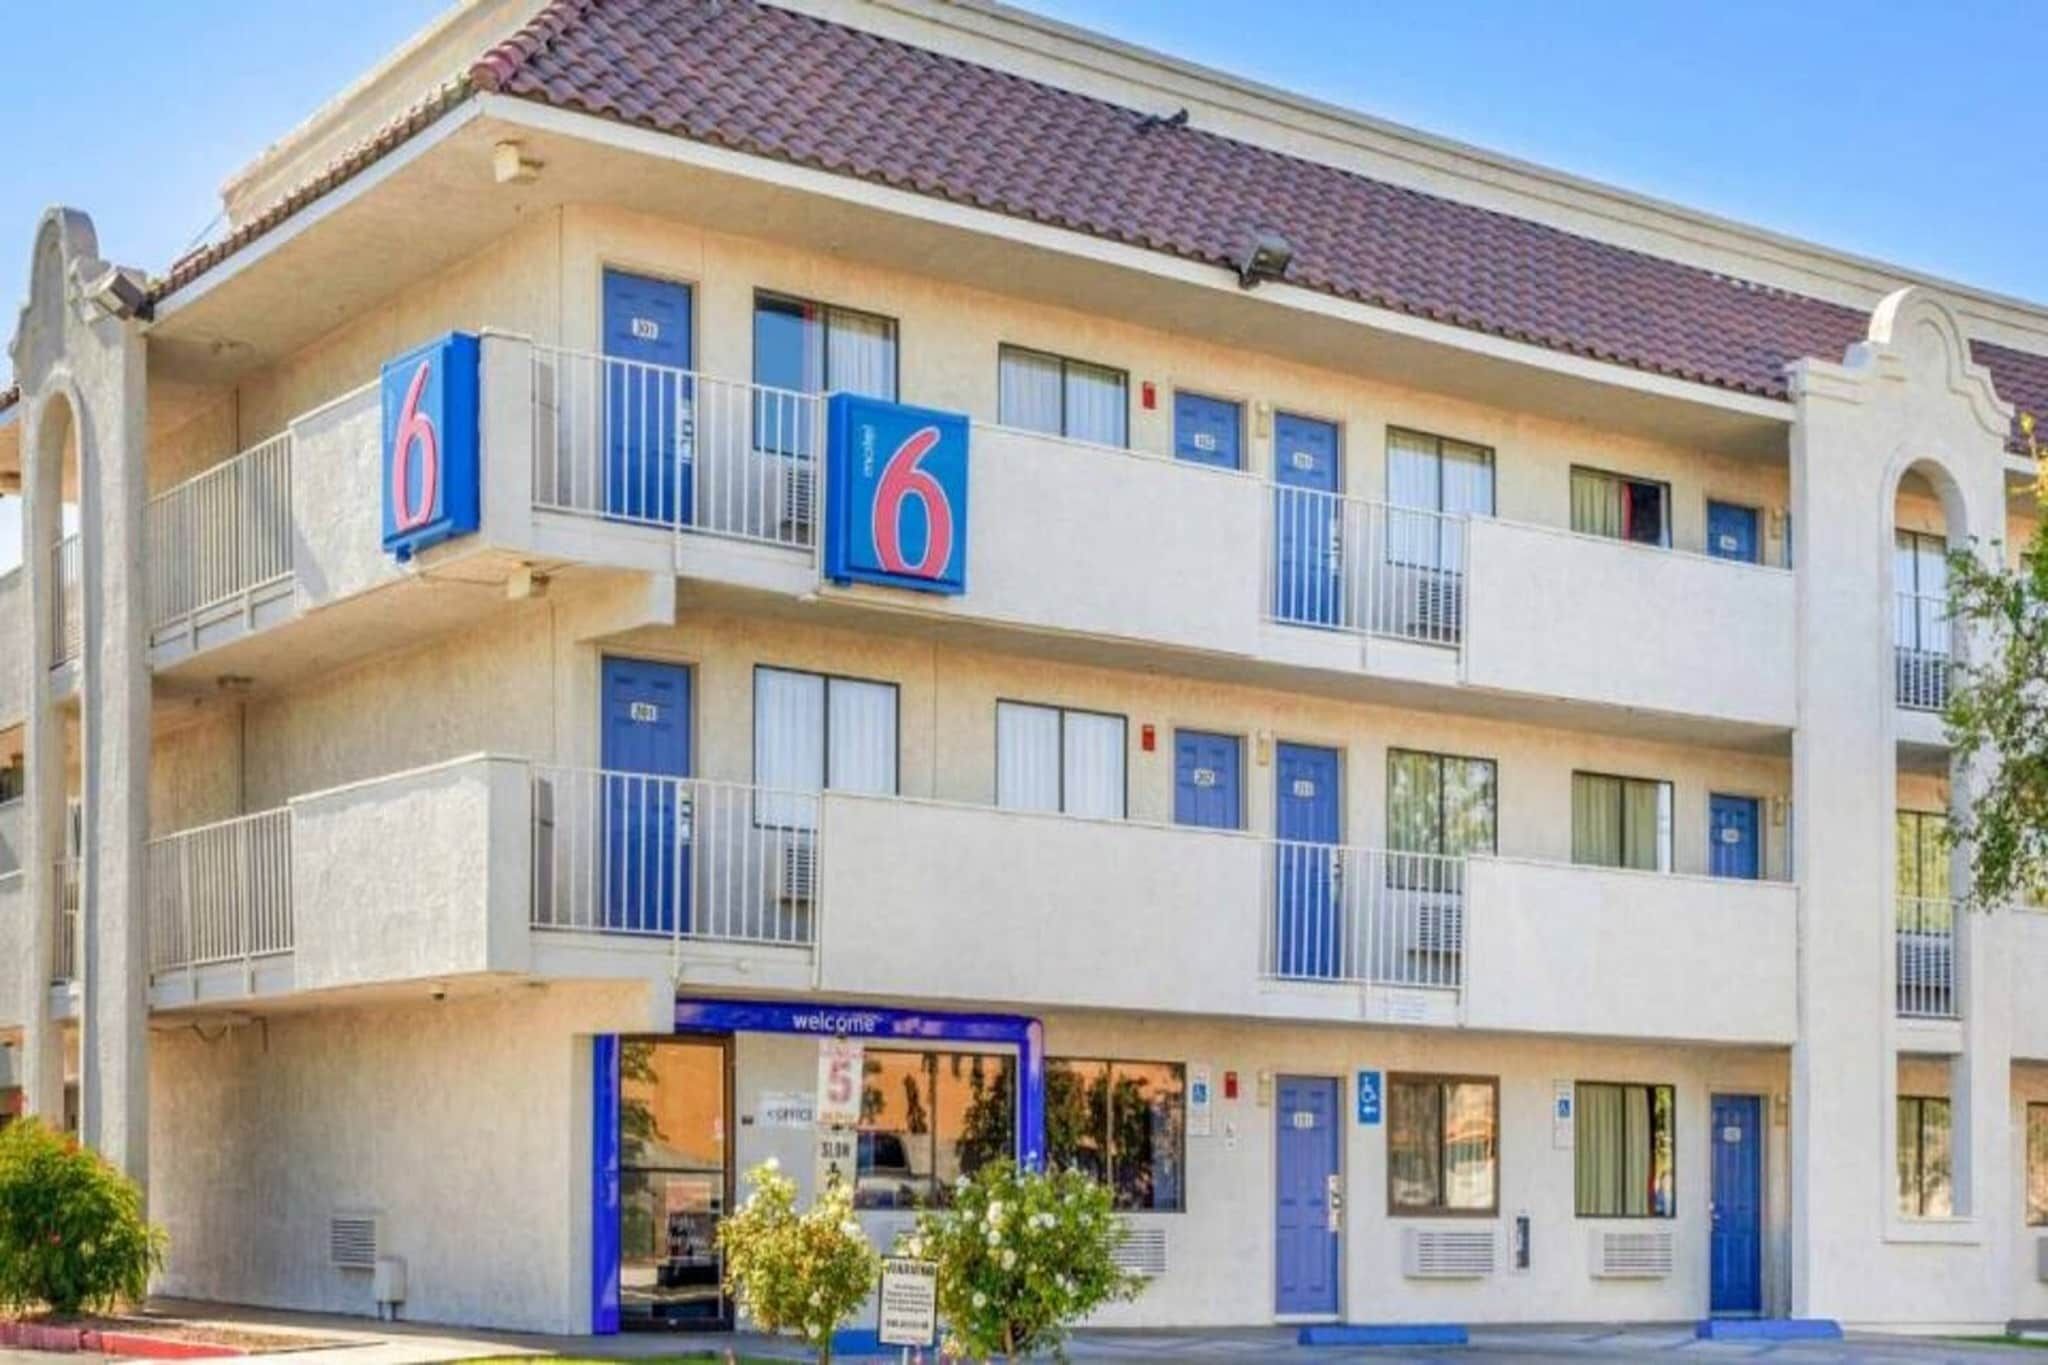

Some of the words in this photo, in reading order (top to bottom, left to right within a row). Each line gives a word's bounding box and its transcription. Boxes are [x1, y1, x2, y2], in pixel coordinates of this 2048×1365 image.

[393, 359, 438, 532] 6
[872, 426, 953, 580] 6
[793, 1011, 876, 1033] welcome
[829, 1060, 852, 1104] 5
